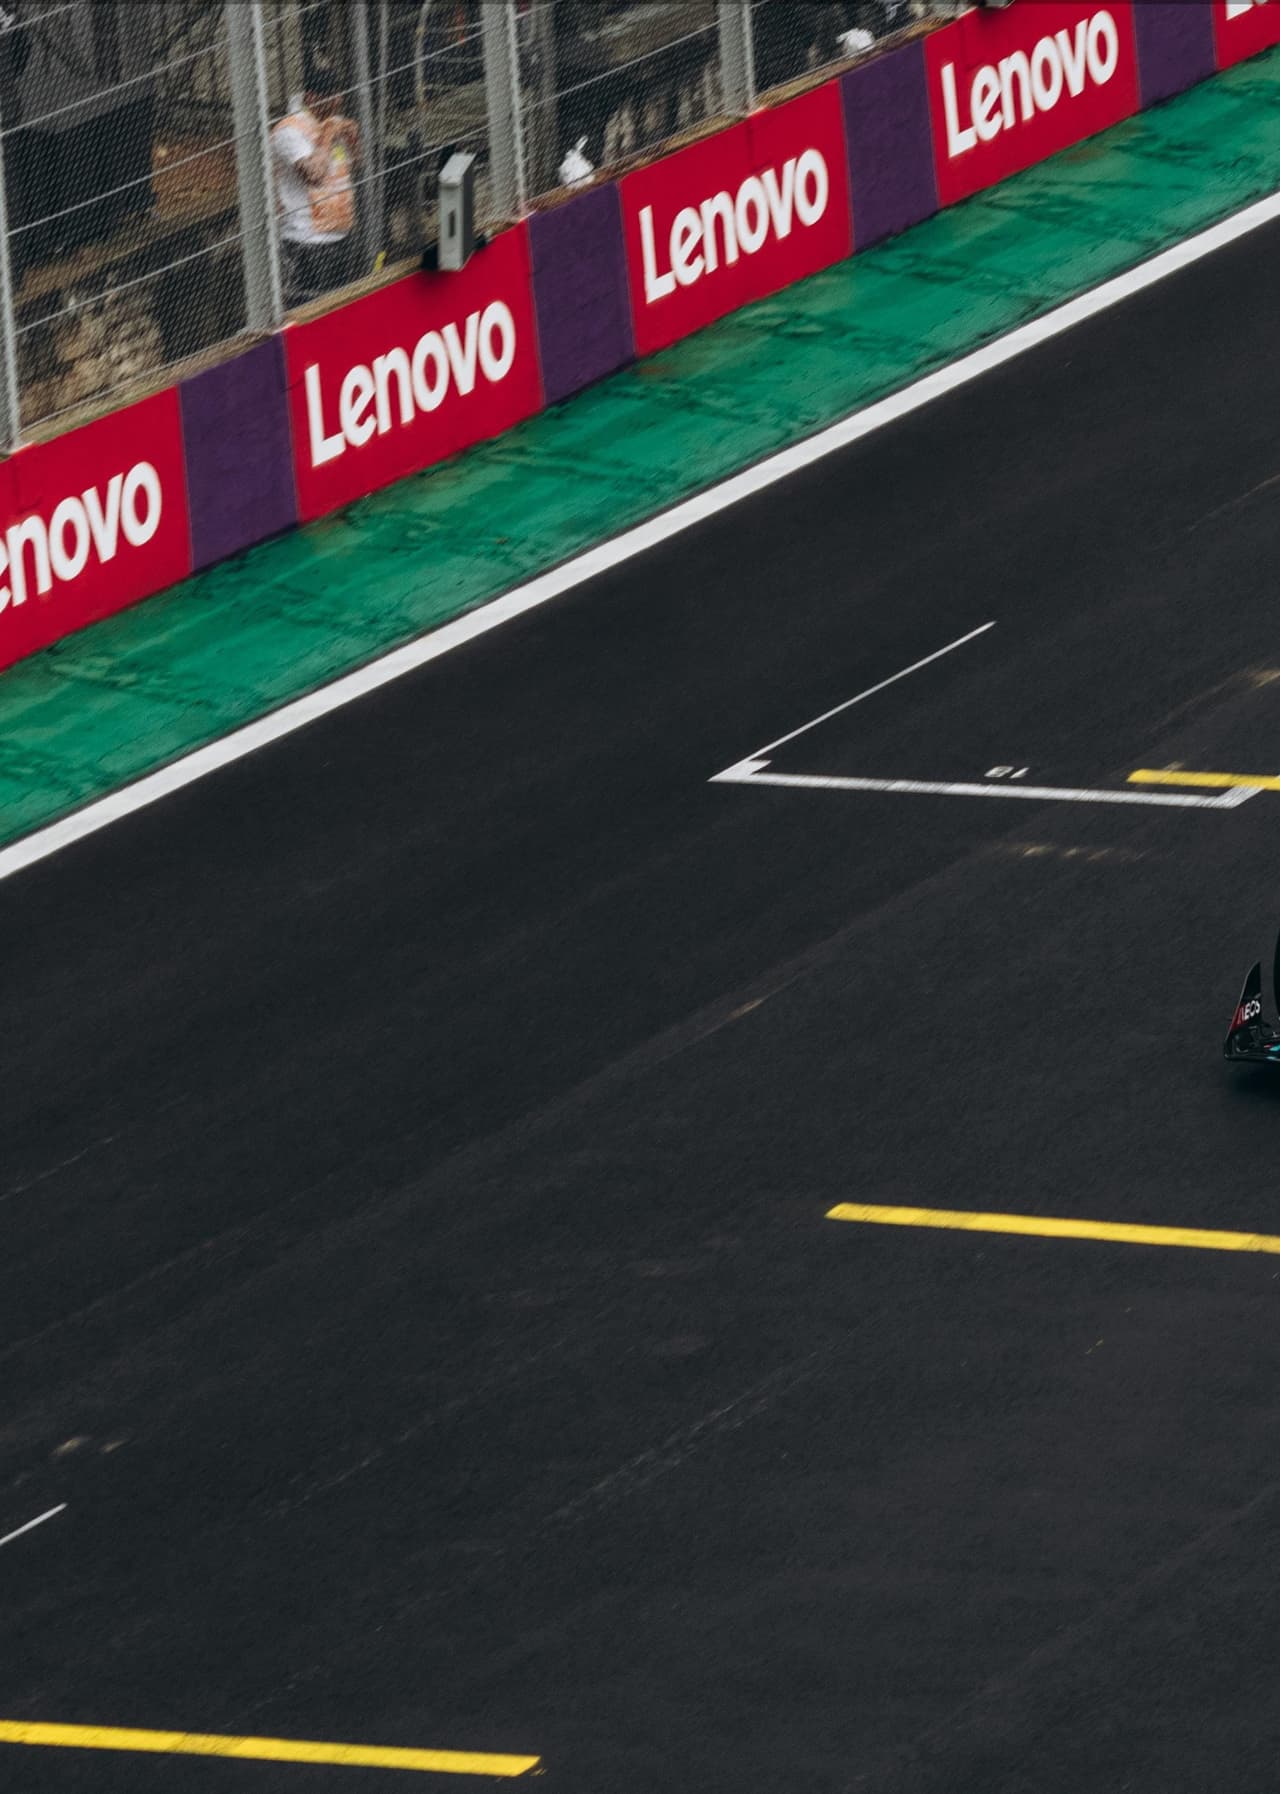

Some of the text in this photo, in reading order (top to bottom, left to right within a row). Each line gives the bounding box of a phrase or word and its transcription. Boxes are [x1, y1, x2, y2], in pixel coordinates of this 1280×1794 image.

[940, 9, 1120, 157] Lenovo
[638, 147, 829, 304] Lenovo
[304, 300, 516, 467] Lenovo
